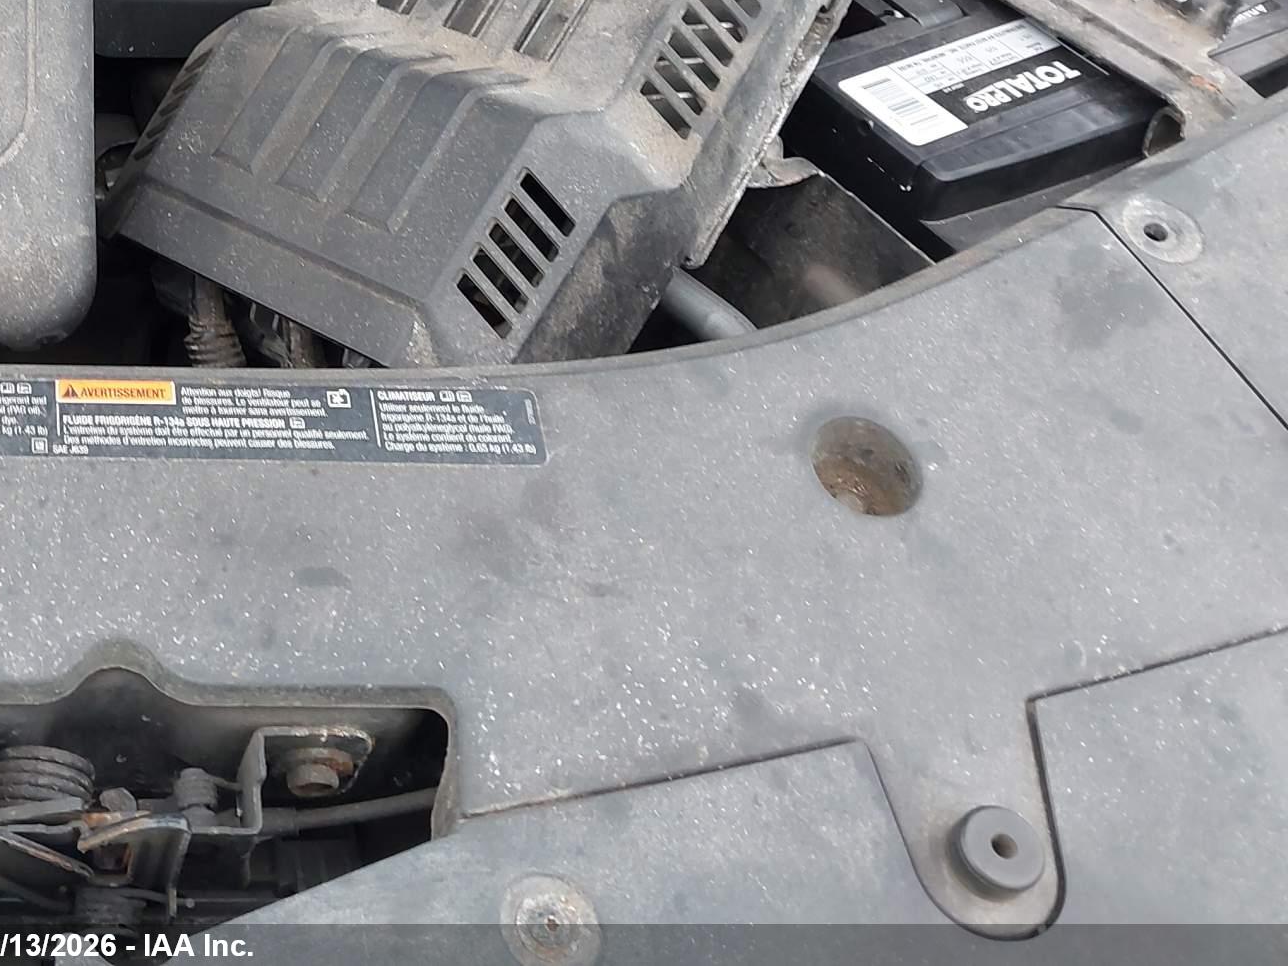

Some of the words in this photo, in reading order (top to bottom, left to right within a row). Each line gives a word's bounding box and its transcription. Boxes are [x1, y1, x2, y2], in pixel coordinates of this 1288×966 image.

[964, 60, 1082, 113] TOTALPRO
[81, 388, 166, 399] AVERTISSEMENT
[181, 387, 216, 397] Attention
[377, 391, 435, 401] CLIMATISEUR
[63, 415, 93, 425] FLUIDE
[153, 416, 184, 426] R-134a
[186, 418, 209, 427] SOUS
[211, 418, 240, 427] HAUTE
[242, 418, 285, 428] PRESSION
[426, 414, 456, 423] R-134a
[2, 425, 12, 436] kg
[252, 430, 291, 439] personnel
[432, 434, 464, 443] contient
[248, 440, 275, 448] causer
[385, 443, 415, 453] Charge
[53, 445, 68, 454] SAE
